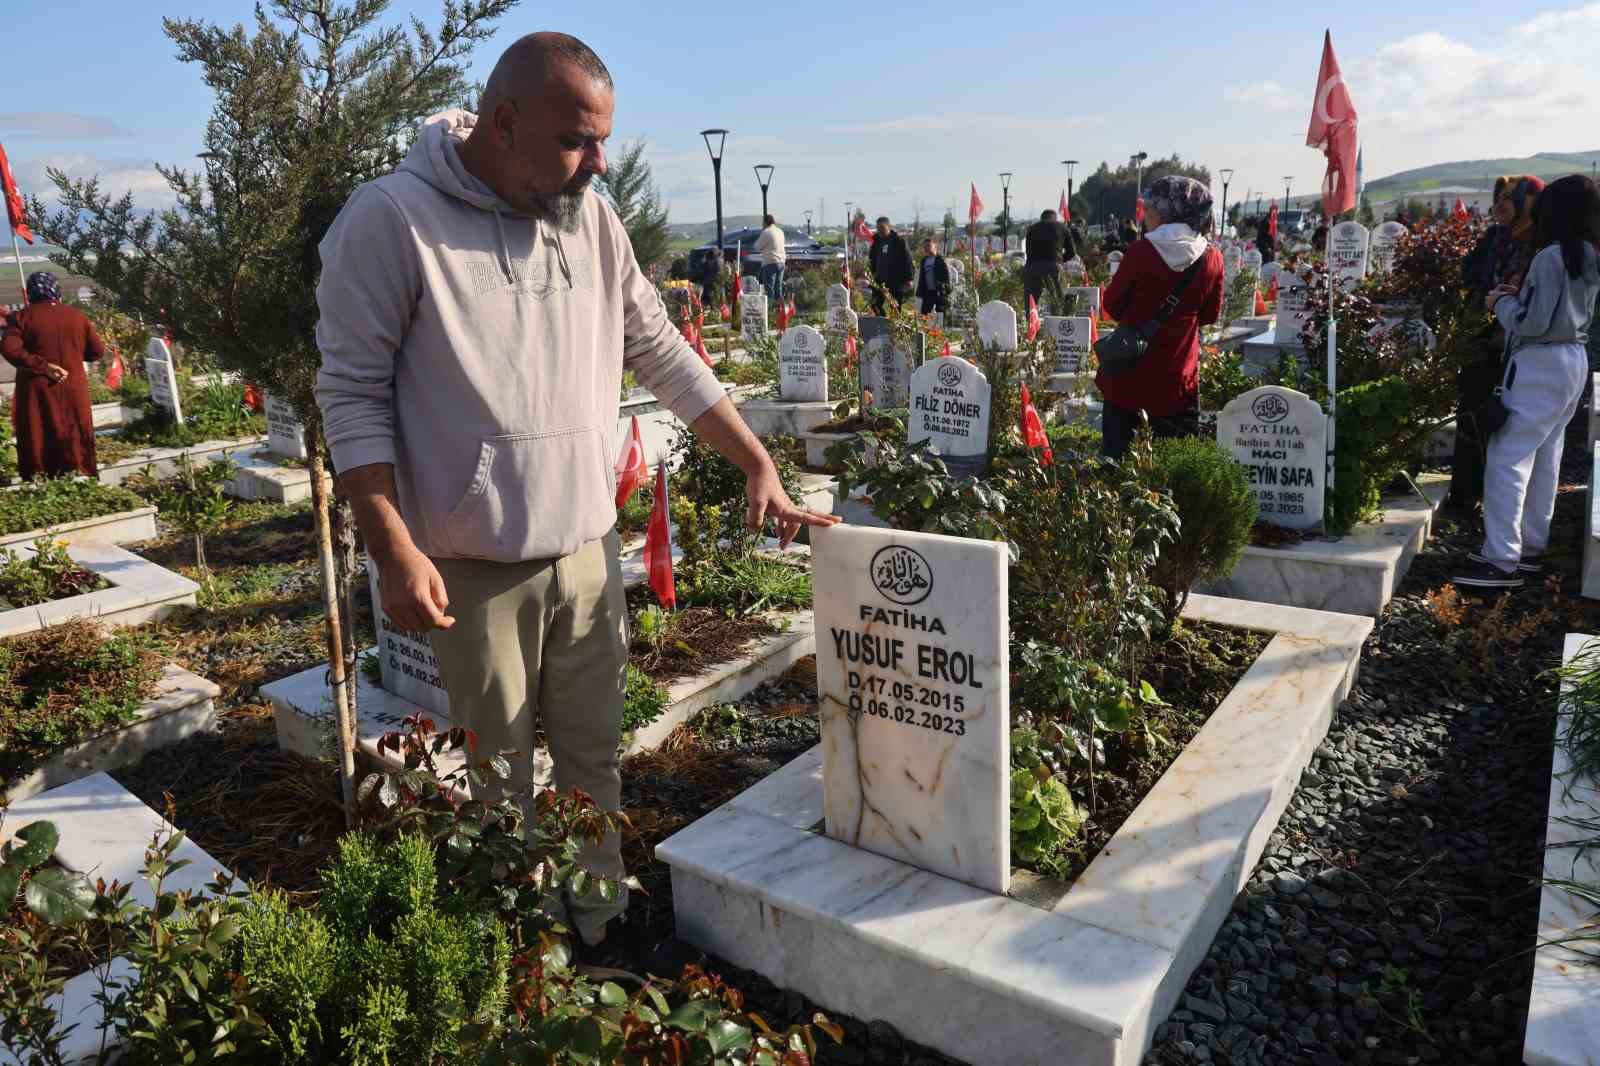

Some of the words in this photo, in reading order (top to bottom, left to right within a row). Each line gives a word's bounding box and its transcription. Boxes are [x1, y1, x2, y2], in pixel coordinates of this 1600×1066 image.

[915, 394, 940, 412] FİLİZ
[943, 398, 980, 419] DÖNER
[1251, 449, 1287, 460] HACI
[1281, 466, 1314, 488] SAFA
[860, 605, 947, 636] FATİHA
[830, 627, 904, 671] YUSUF
[917, 644, 983, 689] EROL
[848, 671, 966, 713] D.17.05.2015
[849, 691, 966, 736] Ö.06.02.2023
